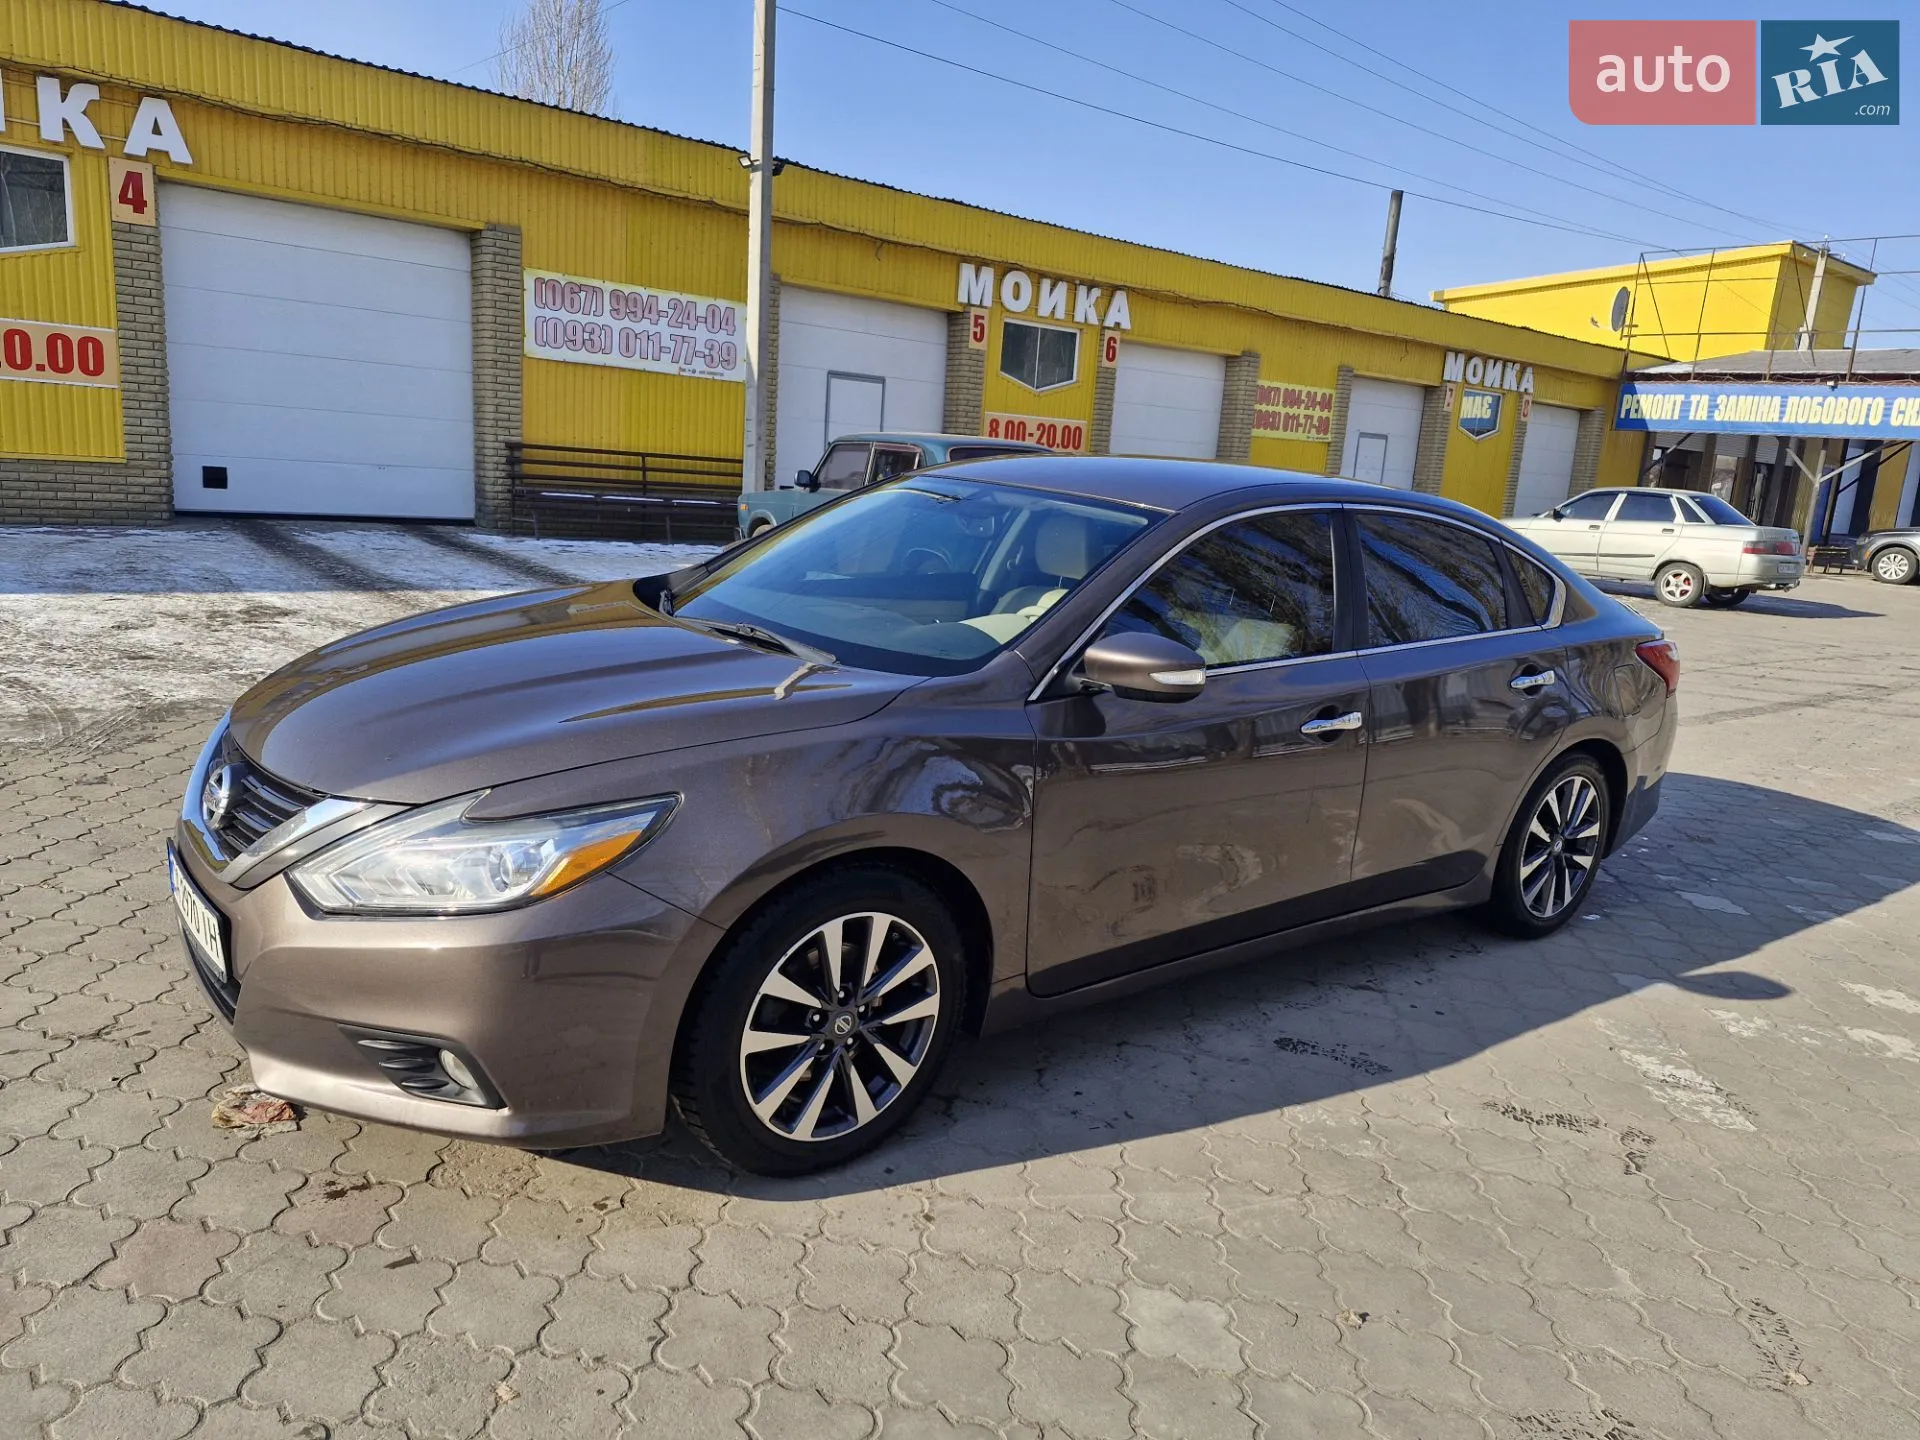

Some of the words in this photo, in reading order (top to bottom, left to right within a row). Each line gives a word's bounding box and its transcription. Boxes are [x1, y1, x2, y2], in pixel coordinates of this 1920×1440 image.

[0, 68, 194, 165] КА
[117, 170, 148, 215] 4
[534, 276, 604, 318] (067)
[609, 288, 737, 337] 994-24-04
[972, 314, 986, 344] 5
[0, 327, 105, 378] 0.00
[534, 315, 613, 355] (093)
[618, 326, 738, 371] 011-77-39
[1105, 336, 1118, 363] 6
[1620, 393, 1685, 421] РЕМОНТ
[1688, 393, 1710, 421] ТА
[1714, 394, 1781, 424] ЗАМІНА
[1783, 395, 1885, 426] ЛОБОВОГО
